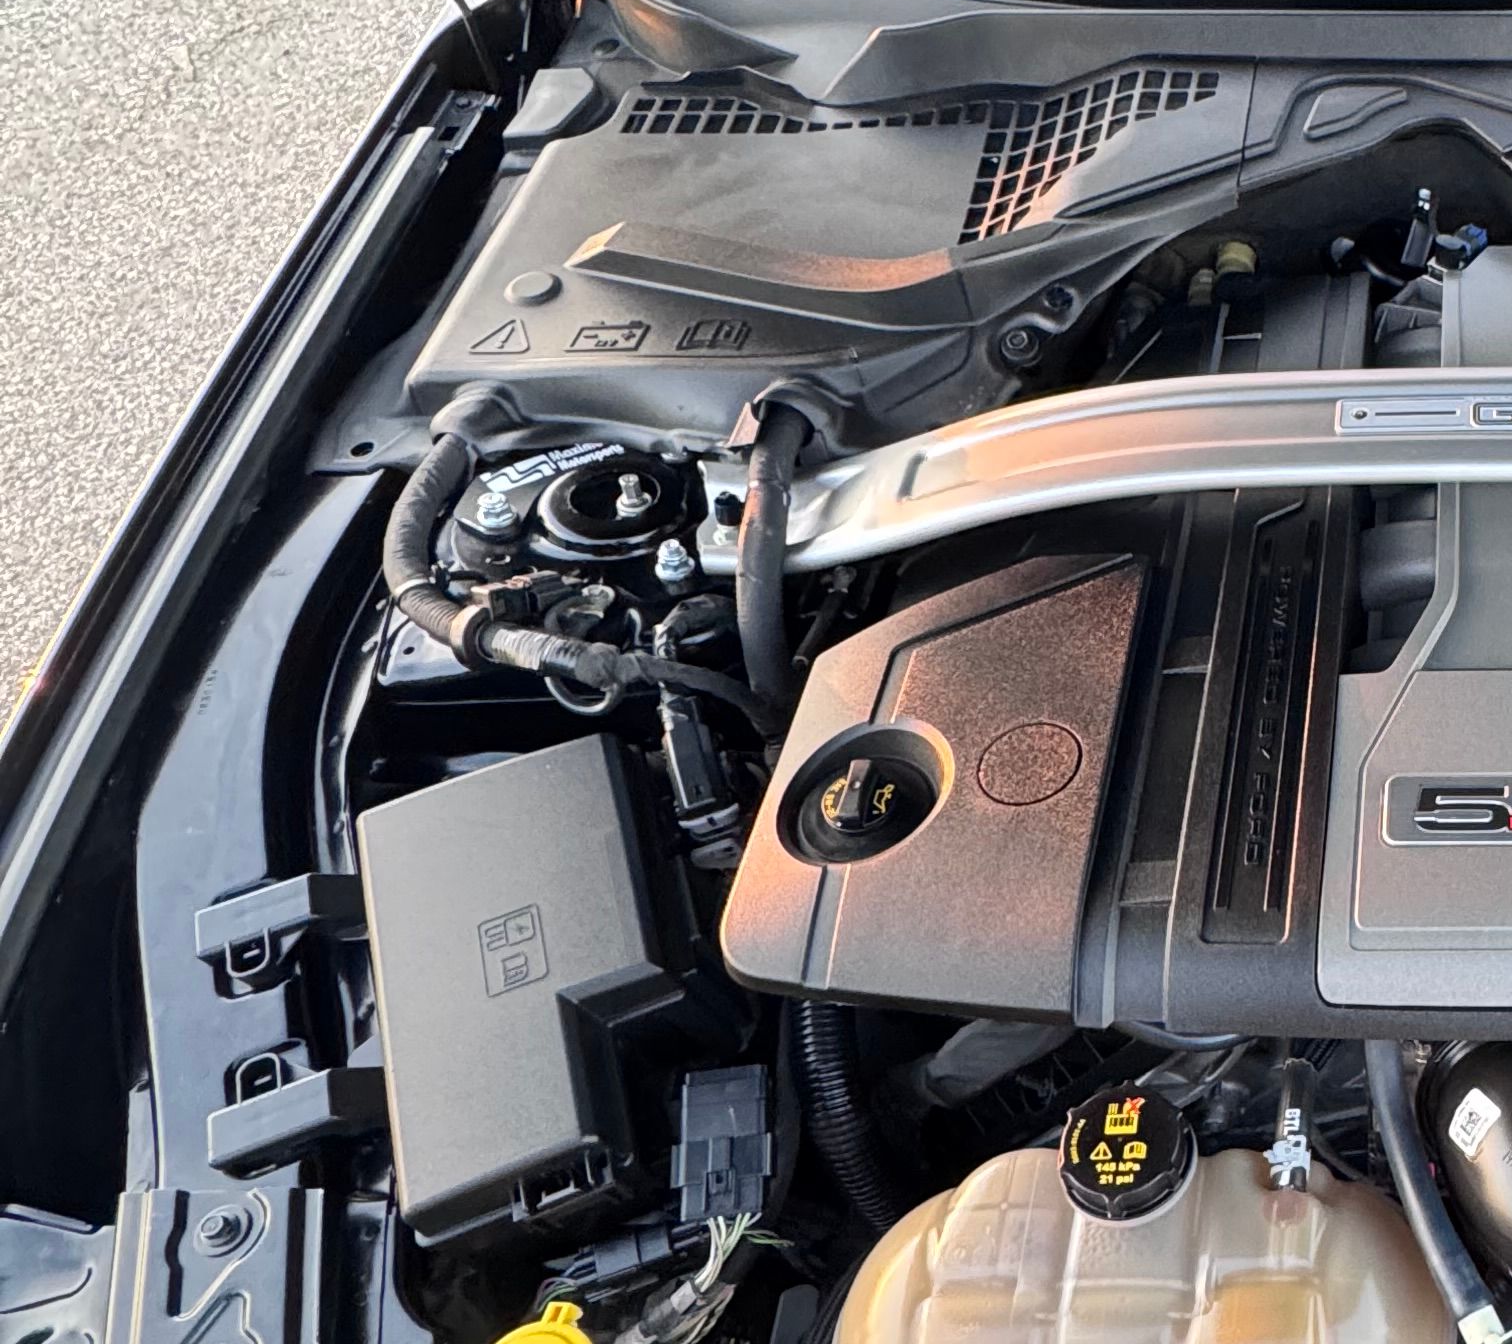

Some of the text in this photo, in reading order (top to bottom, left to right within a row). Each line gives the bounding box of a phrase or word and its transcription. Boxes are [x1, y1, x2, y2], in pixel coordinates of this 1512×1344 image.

[1283, 1108, 1301, 1136] BTL
[1118, 1160, 1140, 1171] kPa
[1099, 1174, 1134, 1185] 21 psi
